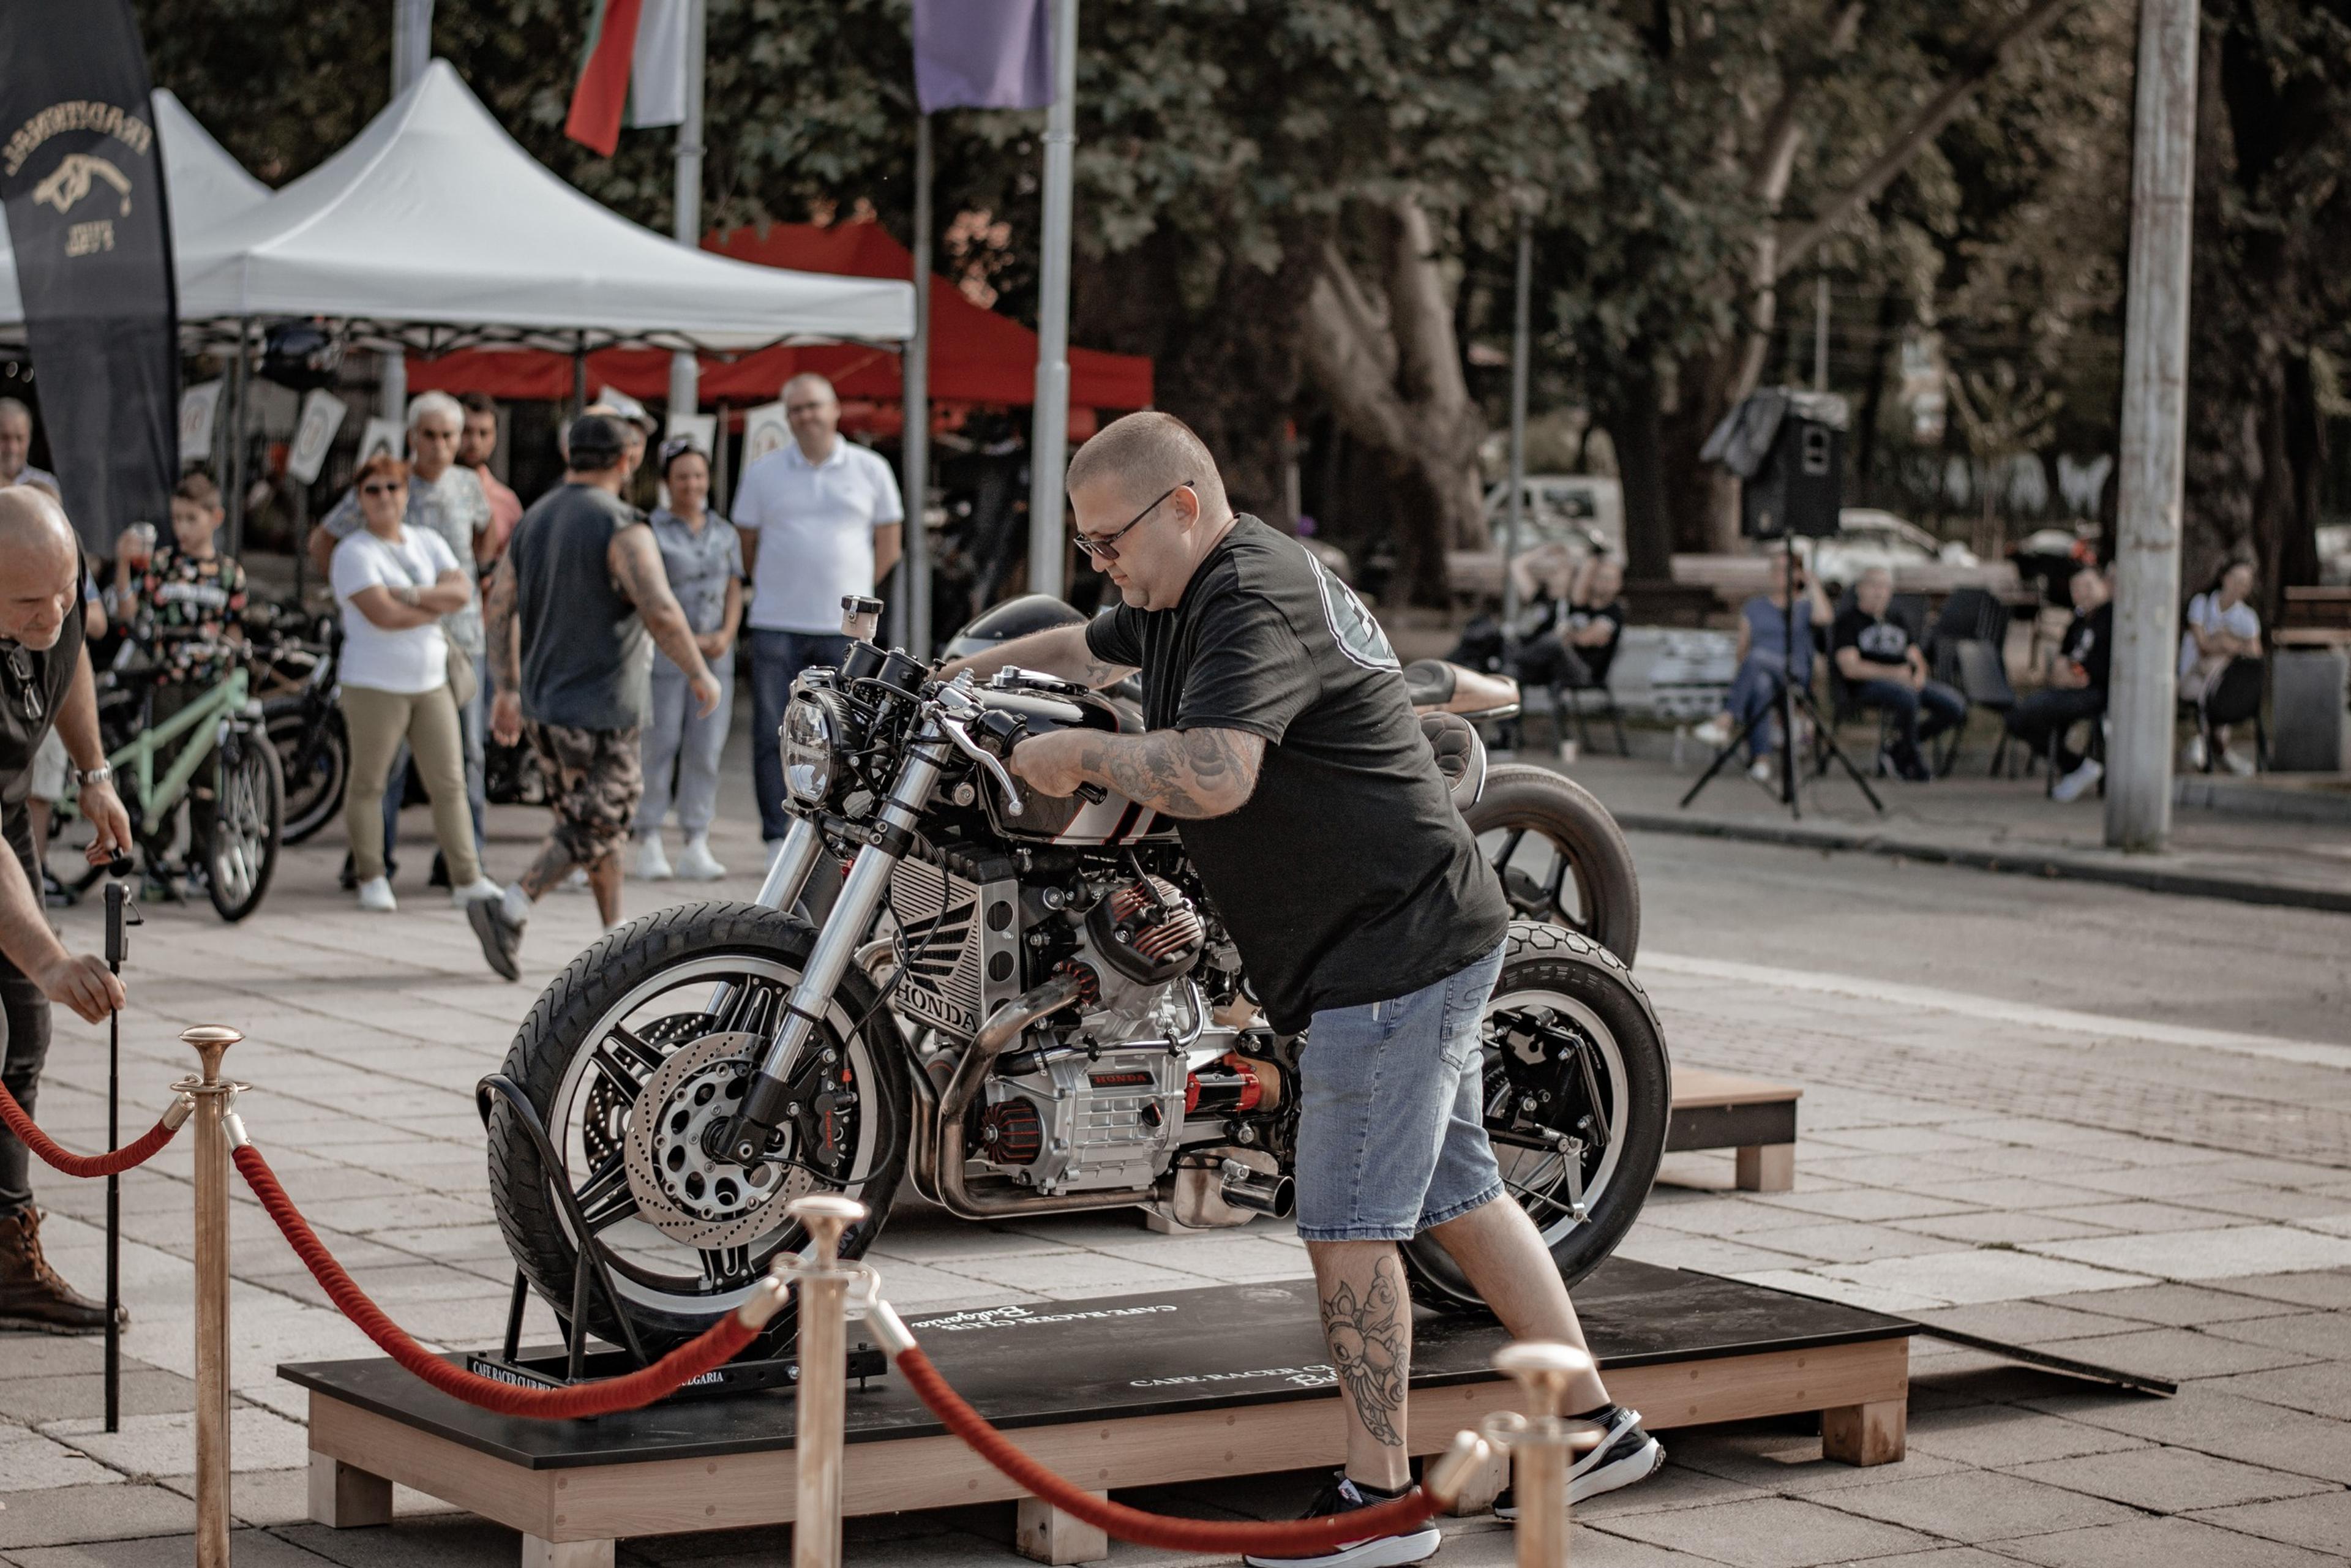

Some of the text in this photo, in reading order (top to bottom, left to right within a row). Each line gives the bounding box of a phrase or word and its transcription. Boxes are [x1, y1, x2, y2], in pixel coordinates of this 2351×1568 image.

[1505, 966, 1611, 992] ETZELER
[894, 984, 978, 1033] HONDA
[1094, 1073, 1147, 1084] HONDA
[911, 1305, 1034, 1328] Bulgaria
[941, 1304, 1178, 1331] CAFE RACER CLUB
[473, 1360, 492, 1379] CAFE
[492, 1367, 517, 1387] RACER
[676, 1371, 724, 1386] LGARIA
[1130, 1375, 1207, 1387] CAFE
[1204, 1367, 1303, 1381] RACER
